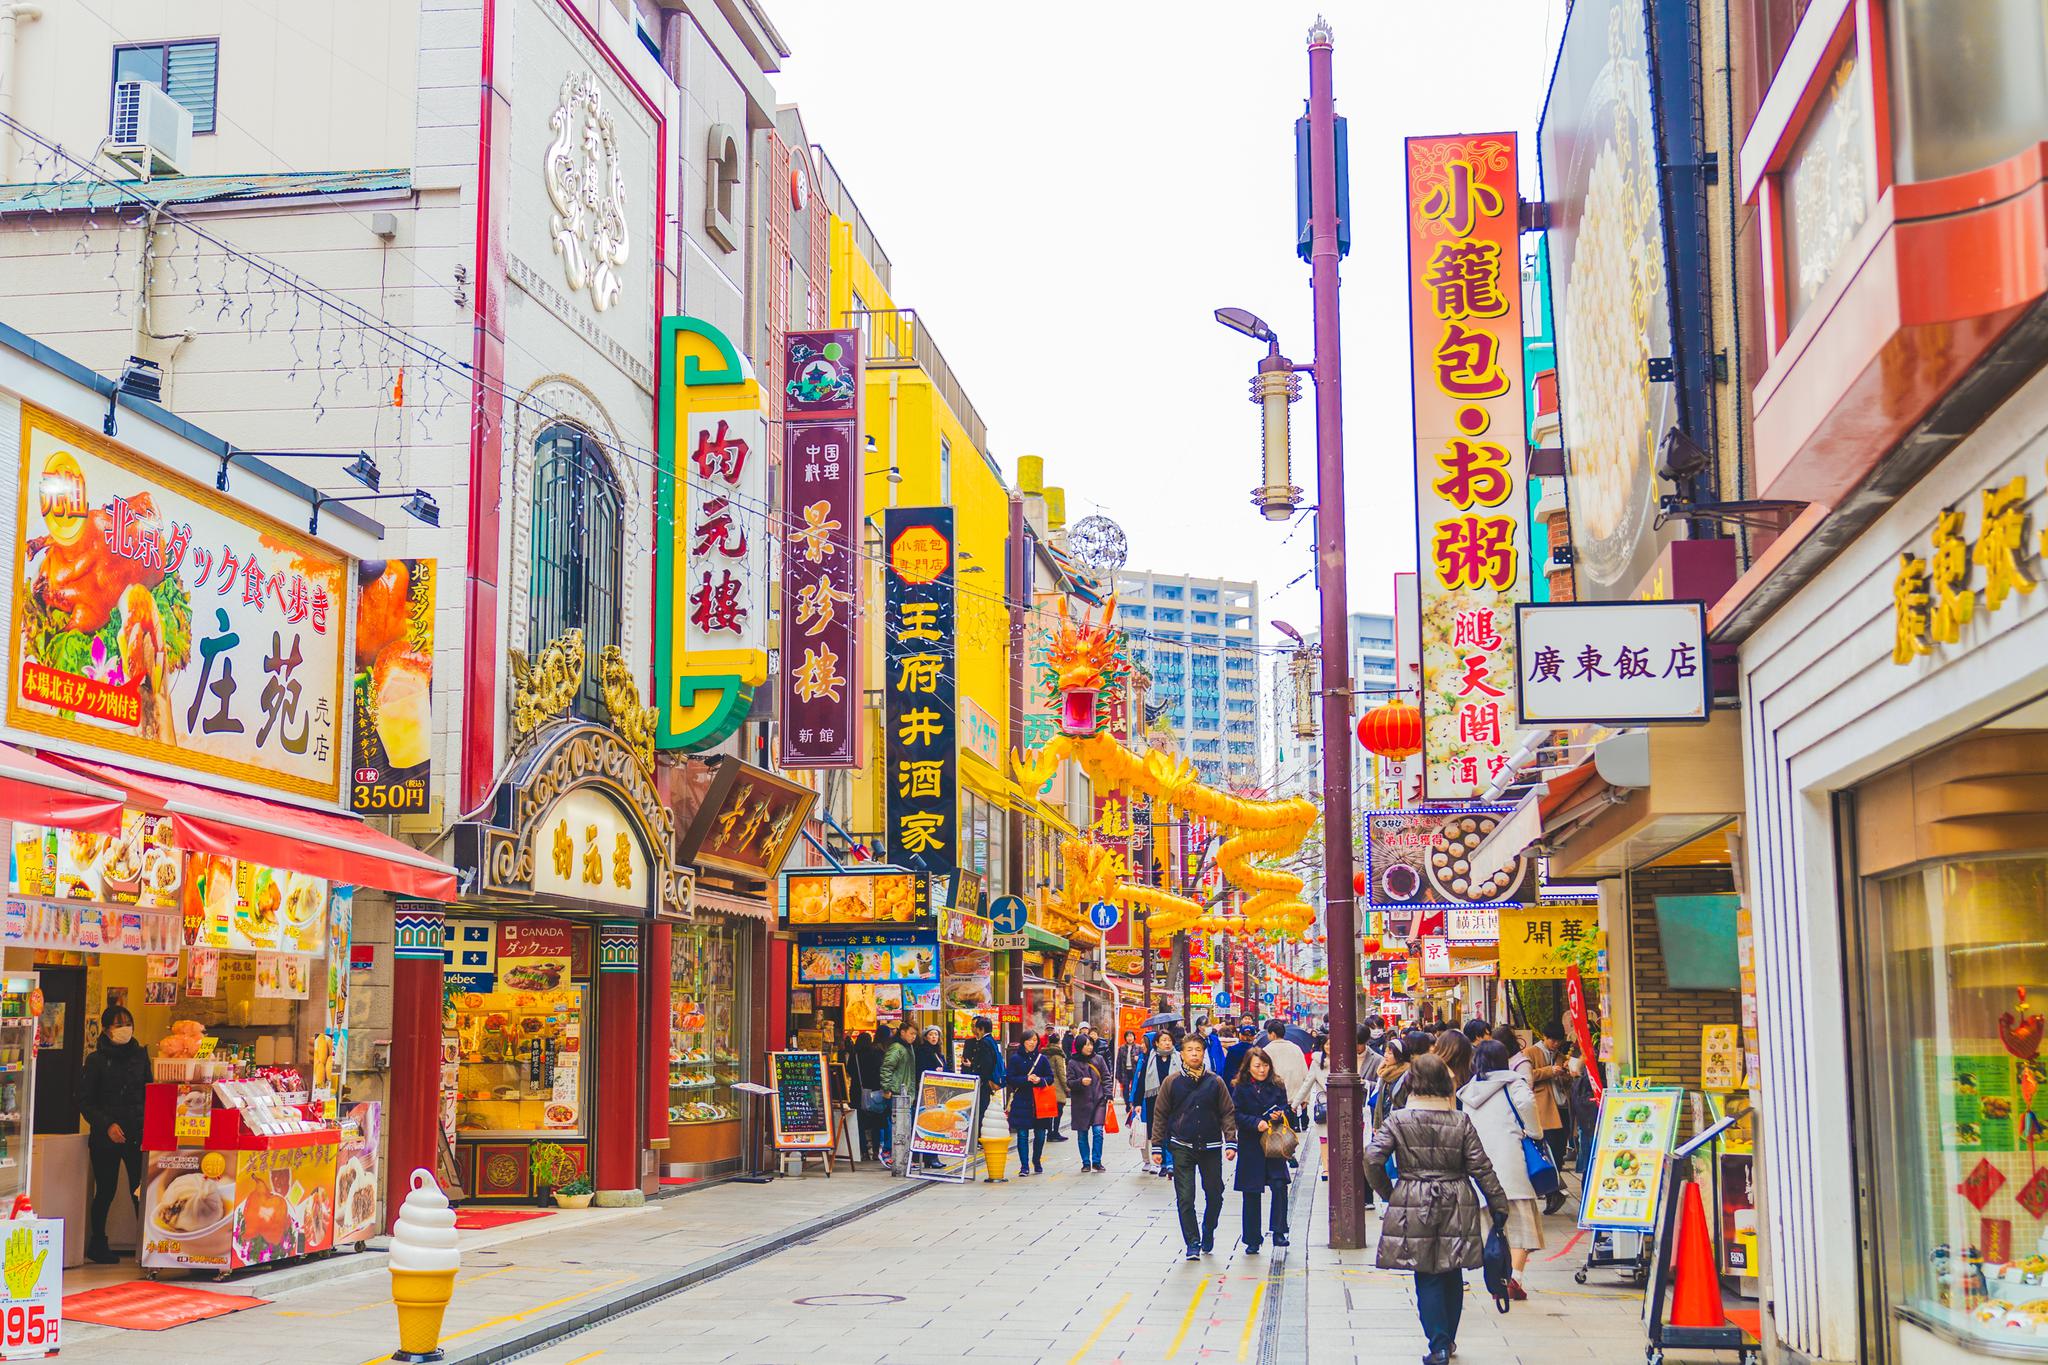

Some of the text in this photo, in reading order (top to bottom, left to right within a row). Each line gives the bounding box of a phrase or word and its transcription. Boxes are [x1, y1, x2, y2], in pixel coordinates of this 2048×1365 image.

[804, 444, 840, 463] 中国
[804, 464, 840, 482] 料理
[104, 494, 330, 635] 北京ダック食べ歩き
[1892, 455, 2048, 665] 廣東飯
[410, 562, 431, 653] 北京ダック
[1527, 642, 1698, 684] 廣東飯店
[187, 607, 310, 756] 庄苑
[24, 670, 140, 723] 本場北京ダック肉付き
[313, 696, 331, 762] 売店
[799, 728, 835, 745] 新館
[896, 602, 945, 852] 王府井酒家
[358, 770, 377, 782] 1枚
[354, 785, 424, 808] 350円
[521, 928, 564, 937] CANADA
[1523, 918, 1598, 947] 開華
[505, 941, 564, 956] ダックフェア
[444, 974, 476, 984] uébec
